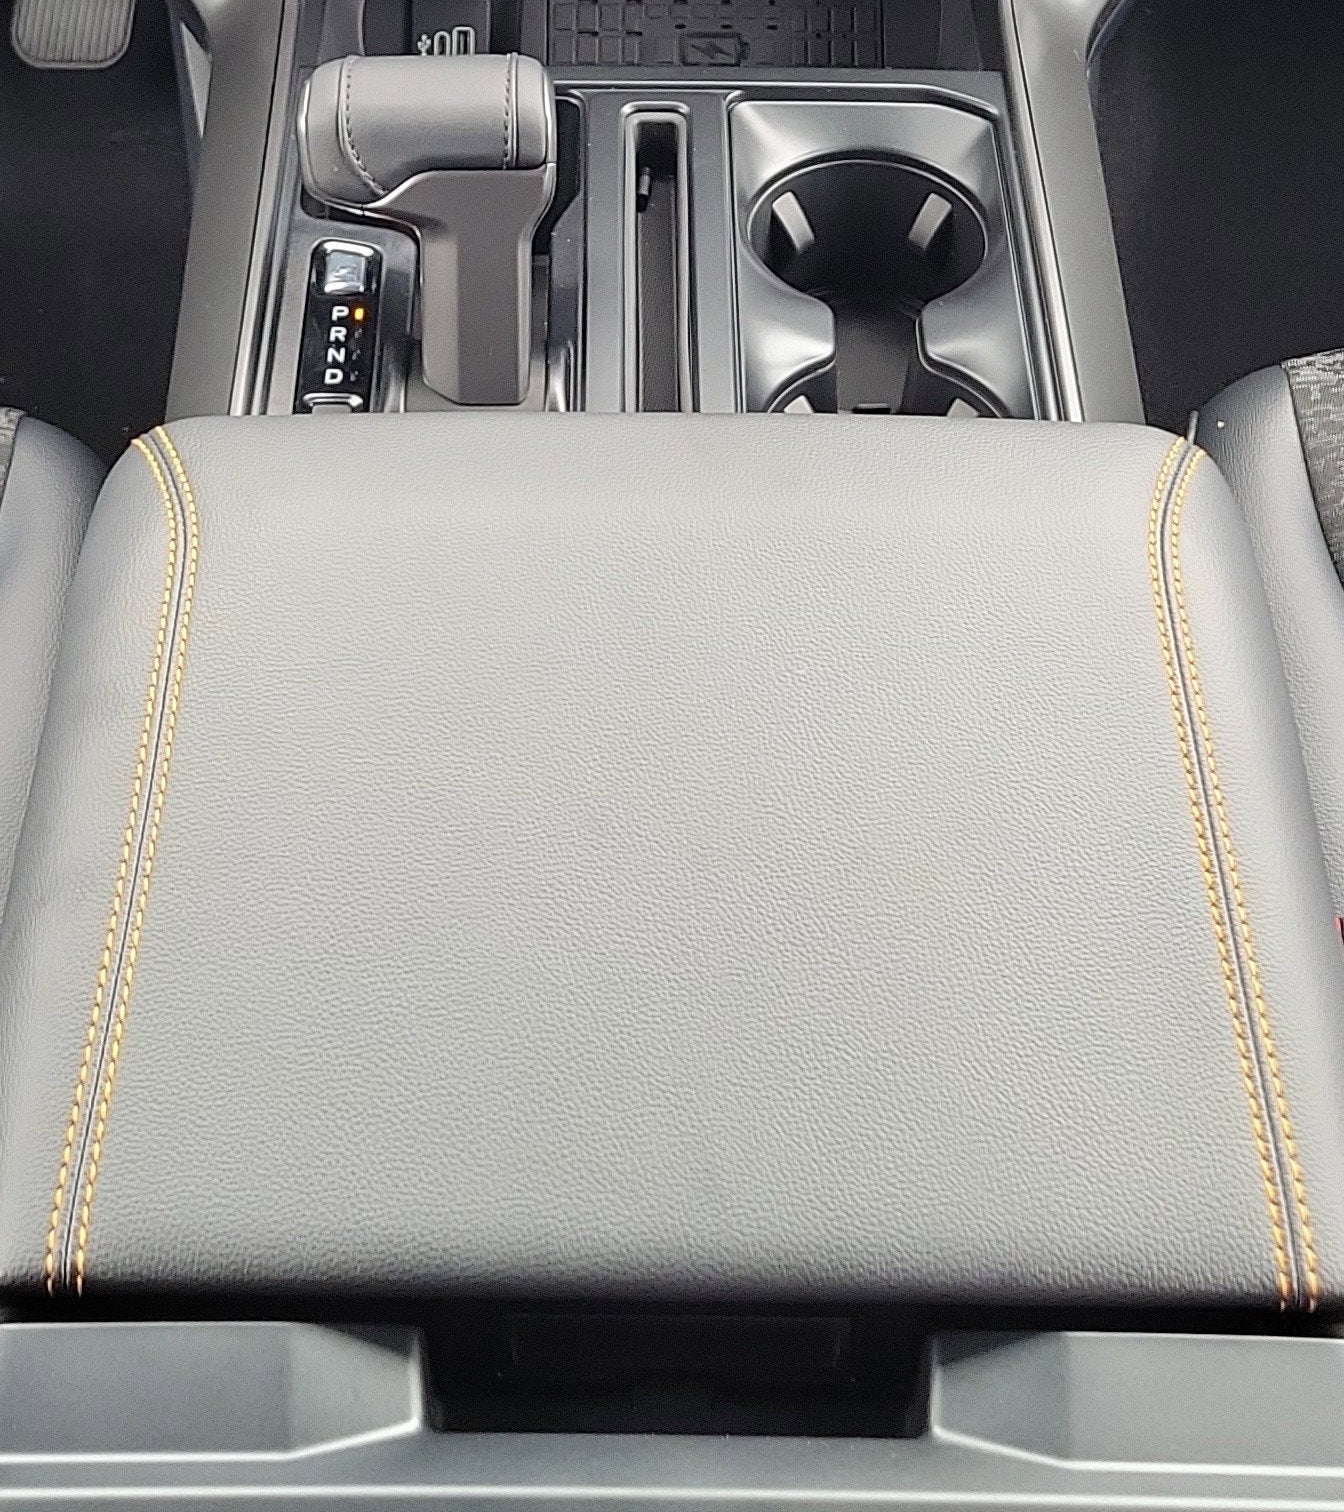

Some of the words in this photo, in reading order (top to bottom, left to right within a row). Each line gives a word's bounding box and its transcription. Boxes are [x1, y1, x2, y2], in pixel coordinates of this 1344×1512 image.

[331, 305, 350, 321] P
[329, 326, 347, 342] R
[326, 347, 346, 363] N
[324, 369, 343, 385] D
